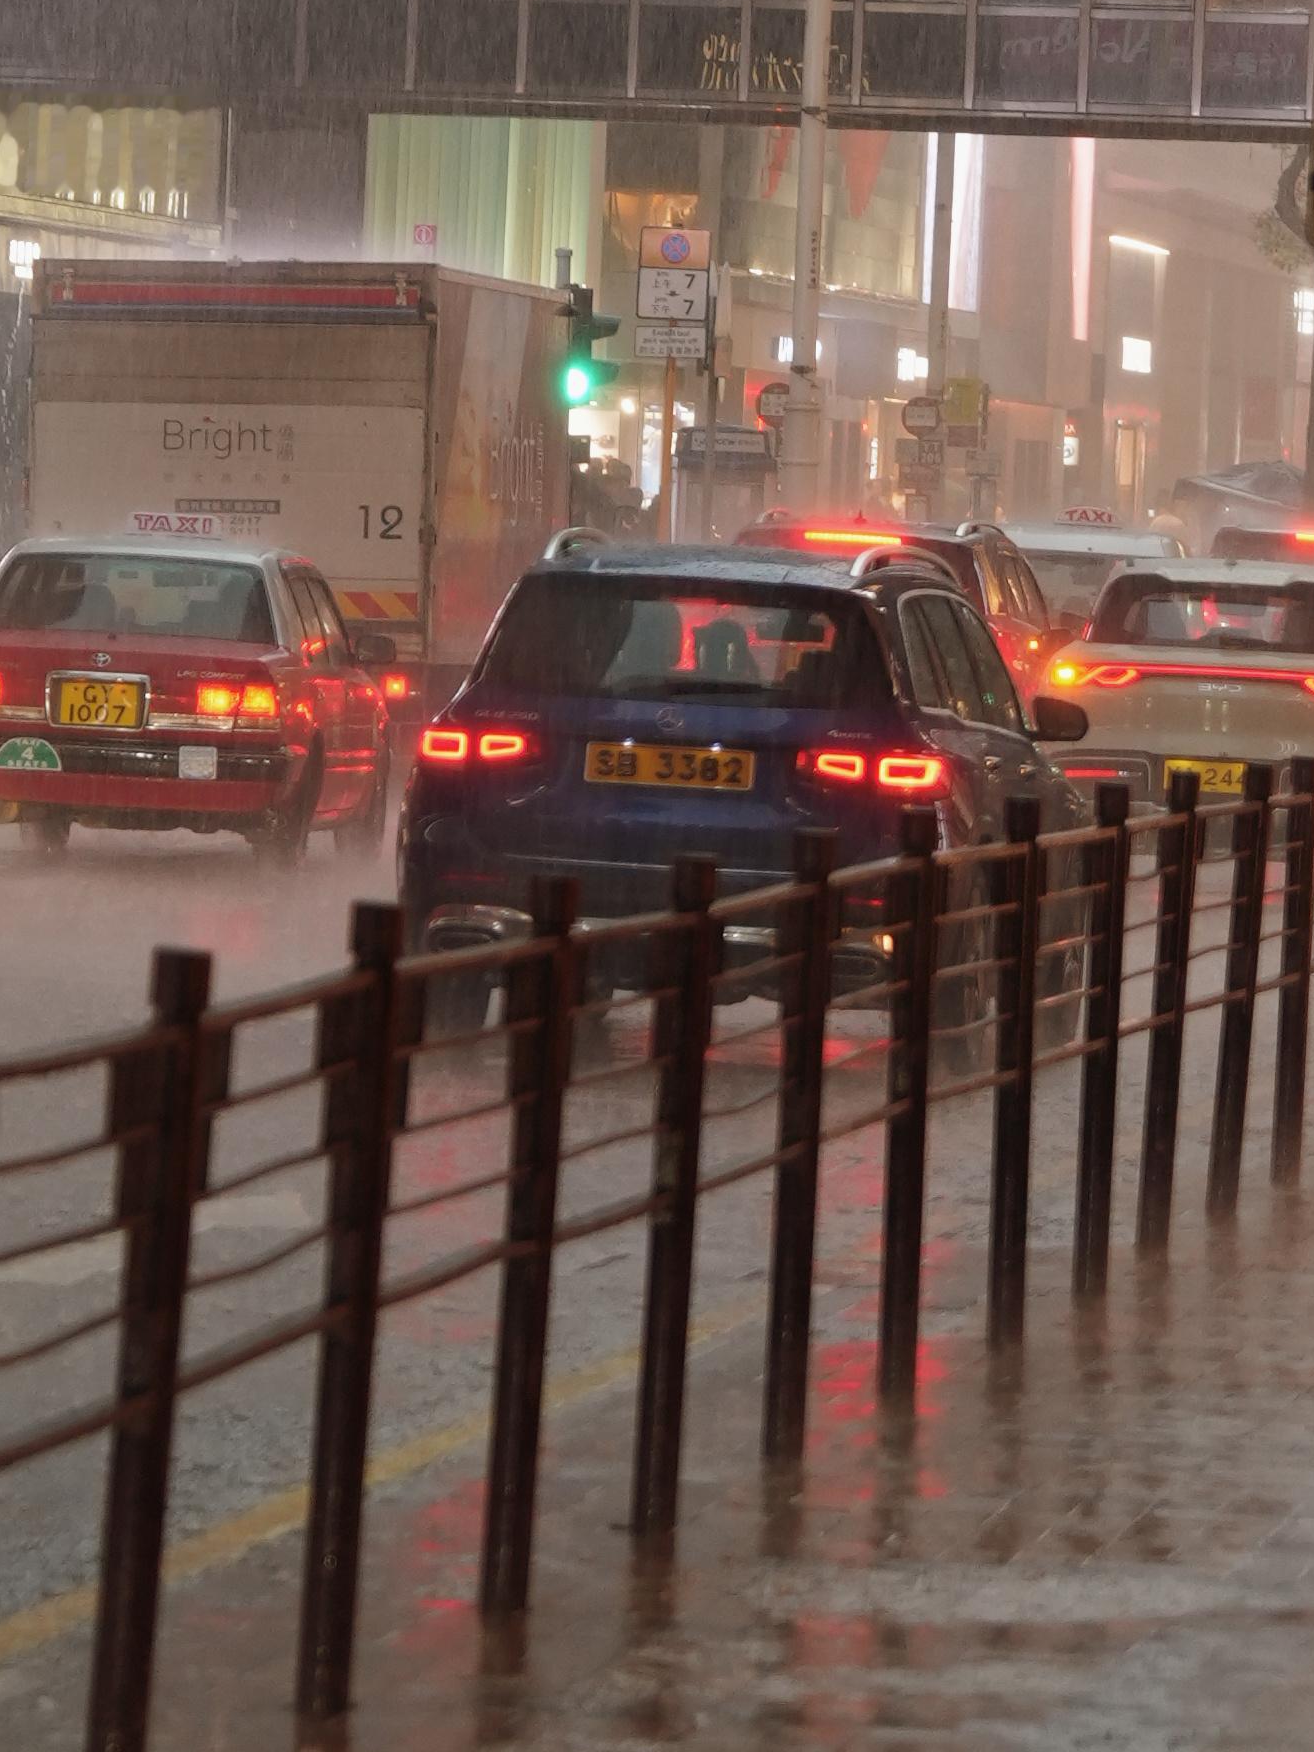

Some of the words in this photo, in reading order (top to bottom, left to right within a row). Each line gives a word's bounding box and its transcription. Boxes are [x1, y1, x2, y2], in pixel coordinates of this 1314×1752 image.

[685, 274, 695, 289] 7
[683, 300, 694, 315] 7
[162, 418, 273, 459] Bright
[133, 514, 212, 535] TAXI
[358, 505, 404, 540] 12
[1065, 508, 1114, 524] TAXI
[1197, 683, 1244, 692] BYD
[69, 704, 127, 724] 1007
[21, 746, 34, 760] 4
[654, 754, 743, 784] 3382
